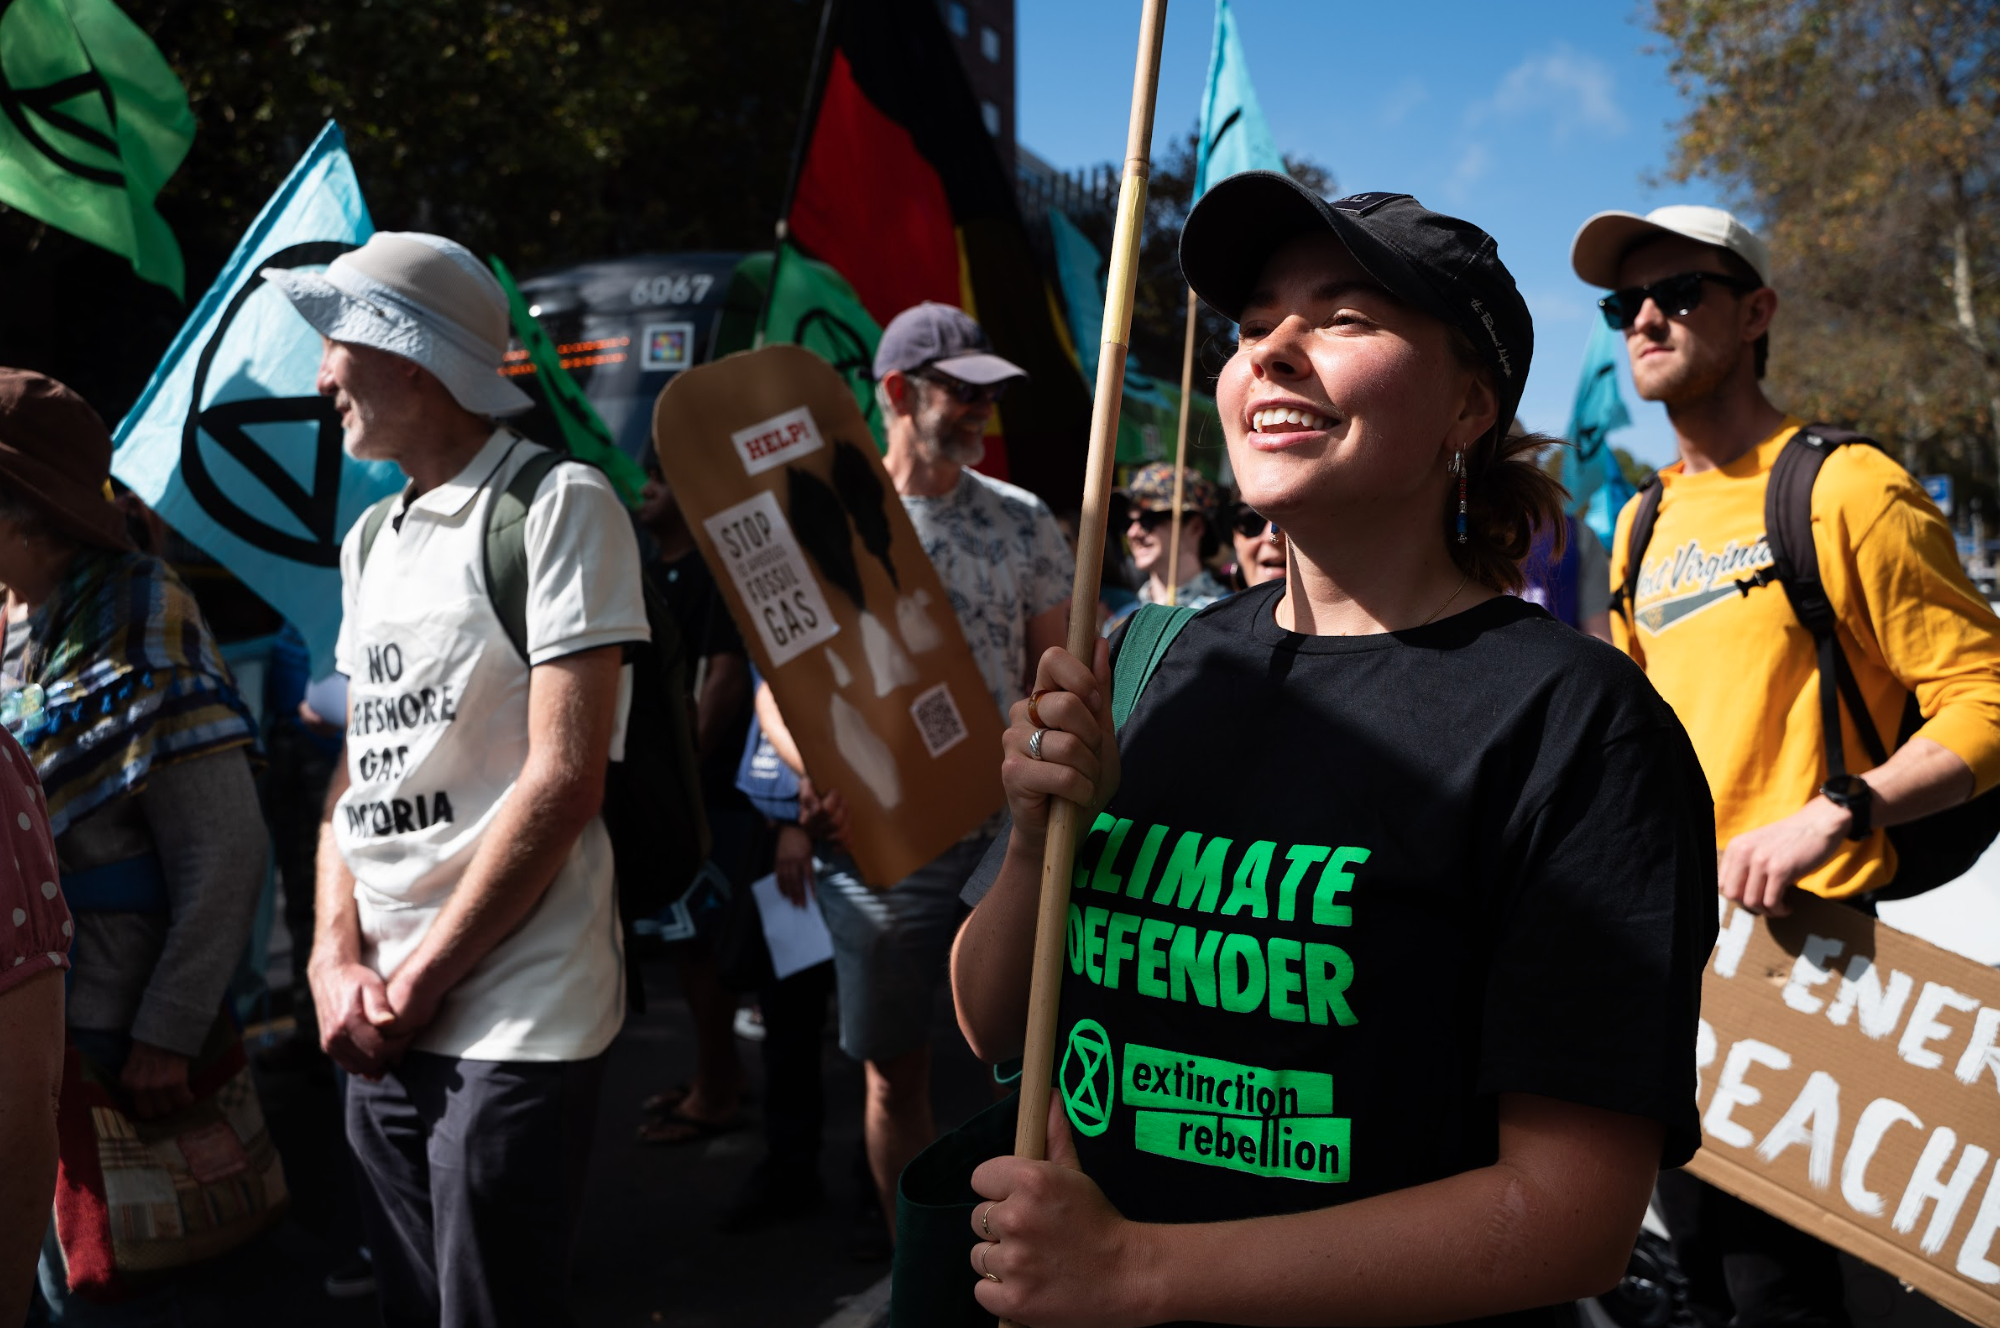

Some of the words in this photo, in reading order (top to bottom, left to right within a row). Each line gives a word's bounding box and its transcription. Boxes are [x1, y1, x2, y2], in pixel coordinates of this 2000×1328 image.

[630, 273, 715, 305] 6067
[743, 418, 811, 462] HELP!
[719, 509, 771, 560] STOP
[744, 561, 801, 606] FOSSIL
[762, 588, 820, 648] GAS
[368, 641, 403, 684] NO
[350, 686, 457, 736] FFSHORE
[359, 745, 409, 782] GAS
[1073, 811, 1372, 928] CLIMATE
[1066, 901, 1360, 1027] DEFENDER
[1132, 1060, 1300, 1116] extinction
[1177, 1114, 1340, 1174] rebellion
